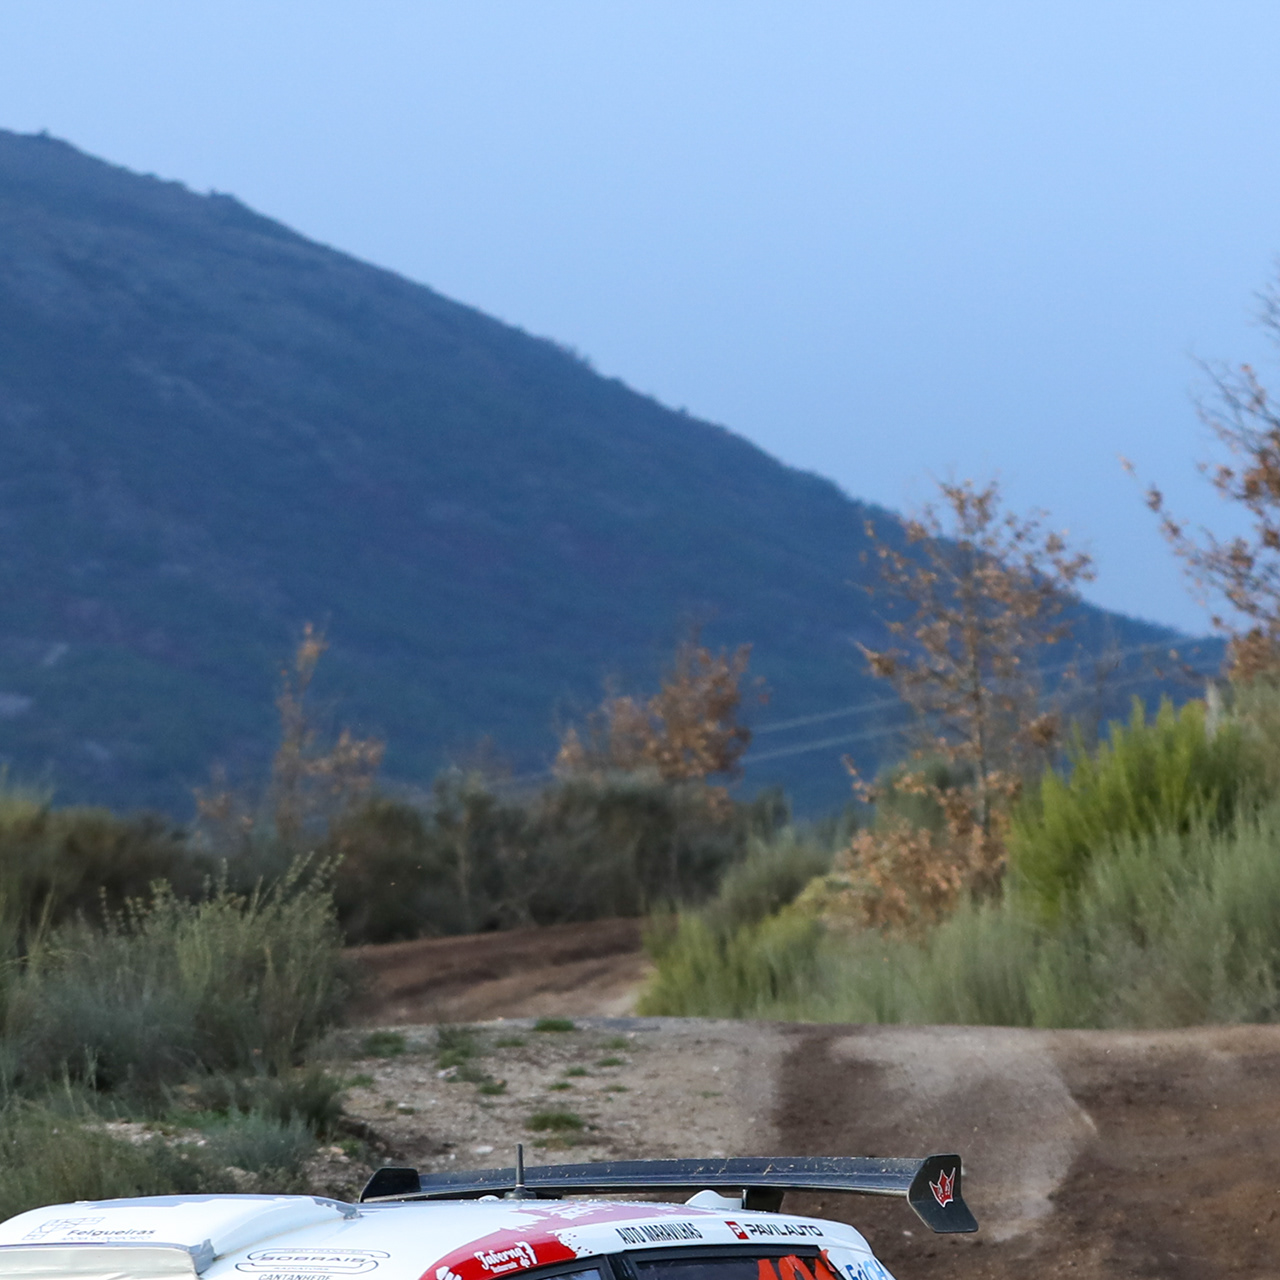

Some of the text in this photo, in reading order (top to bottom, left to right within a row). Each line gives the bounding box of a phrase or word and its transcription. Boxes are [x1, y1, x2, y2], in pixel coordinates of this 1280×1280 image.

[66, 1229, 156, 1237] Felgueiras
[615, 1222, 704, 1245] AUTO MARAVILHAS
[744, 1223, 824, 1237] PAVILAUTO
[473, 1246, 529, 1271] Taberna
